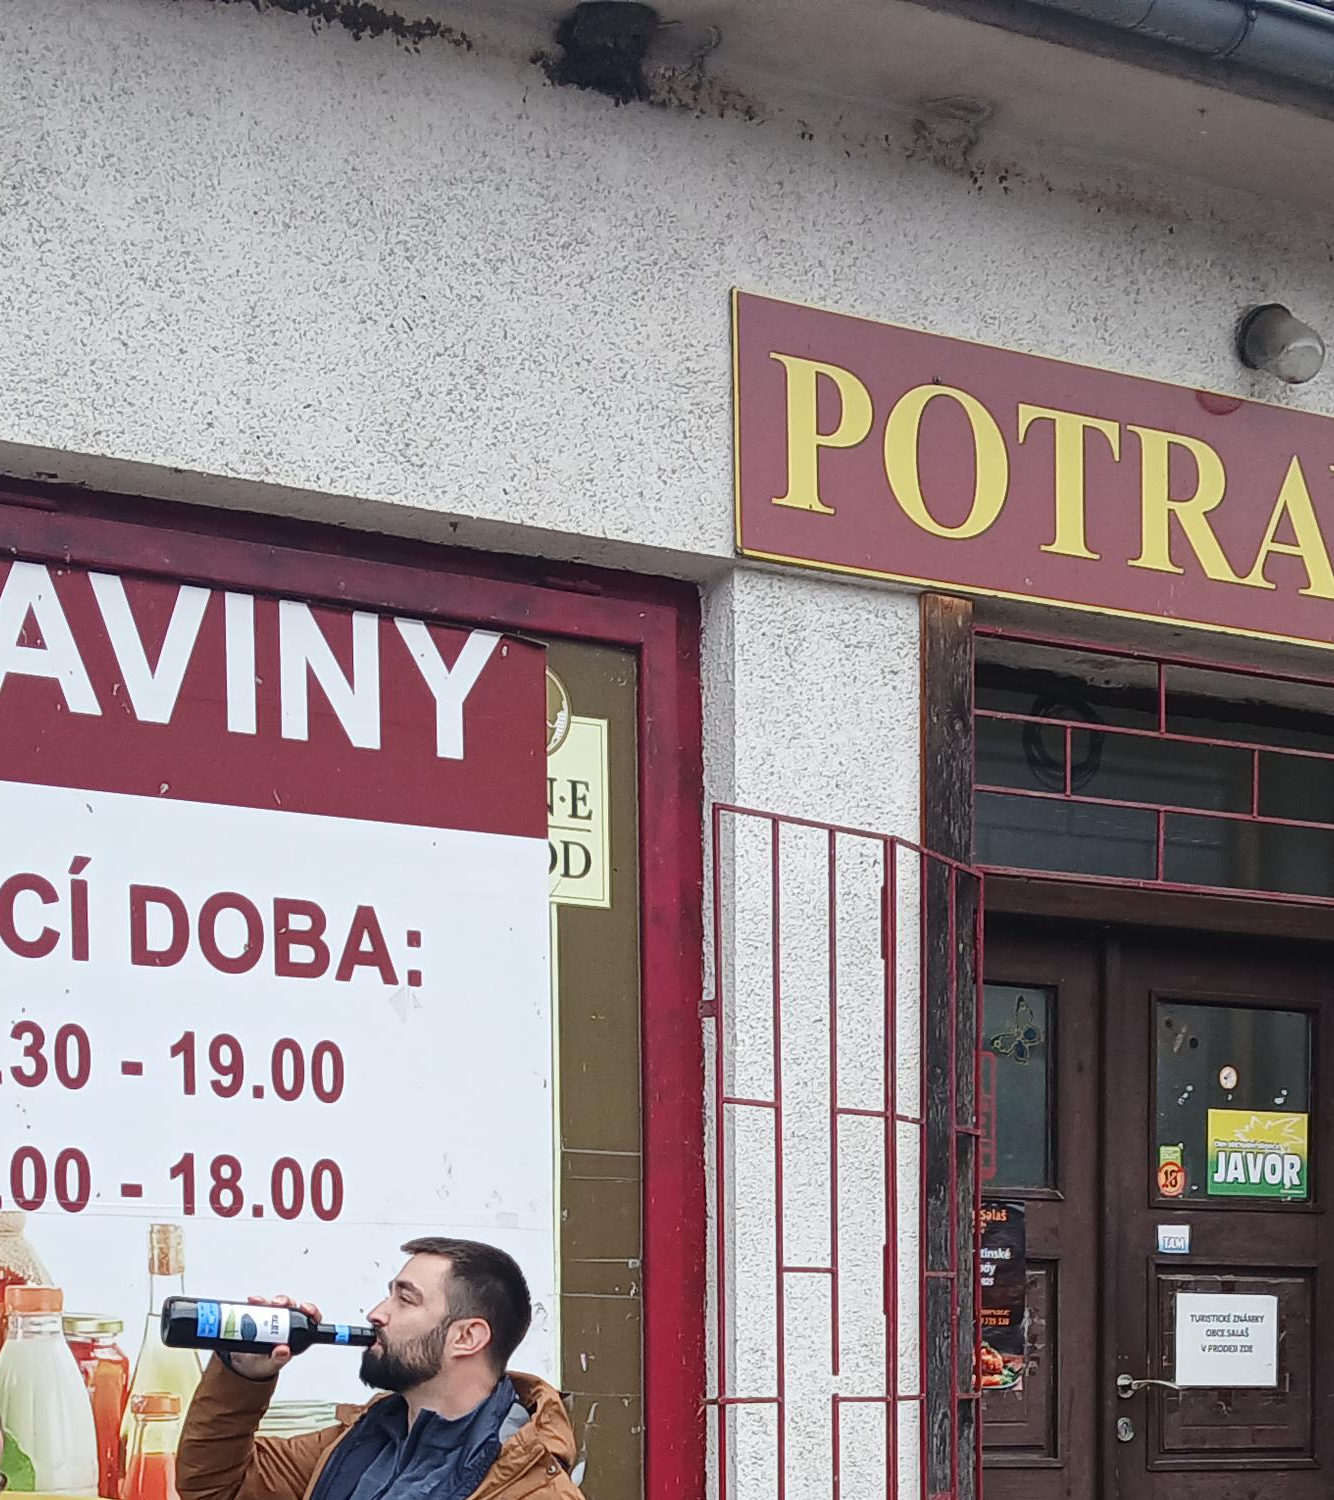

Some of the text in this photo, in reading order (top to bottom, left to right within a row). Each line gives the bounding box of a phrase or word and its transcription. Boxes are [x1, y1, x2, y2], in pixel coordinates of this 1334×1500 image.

[129, 883, 423, 988] DOBA:
[120, 1060, 144, 1077] -
[169, 1030, 345, 1104] 19.00
[120, 1183, 144, 1198] -
[168, 1152, 345, 1222] 18.00
[1213, 1151, 1301, 1187] JAVOR
